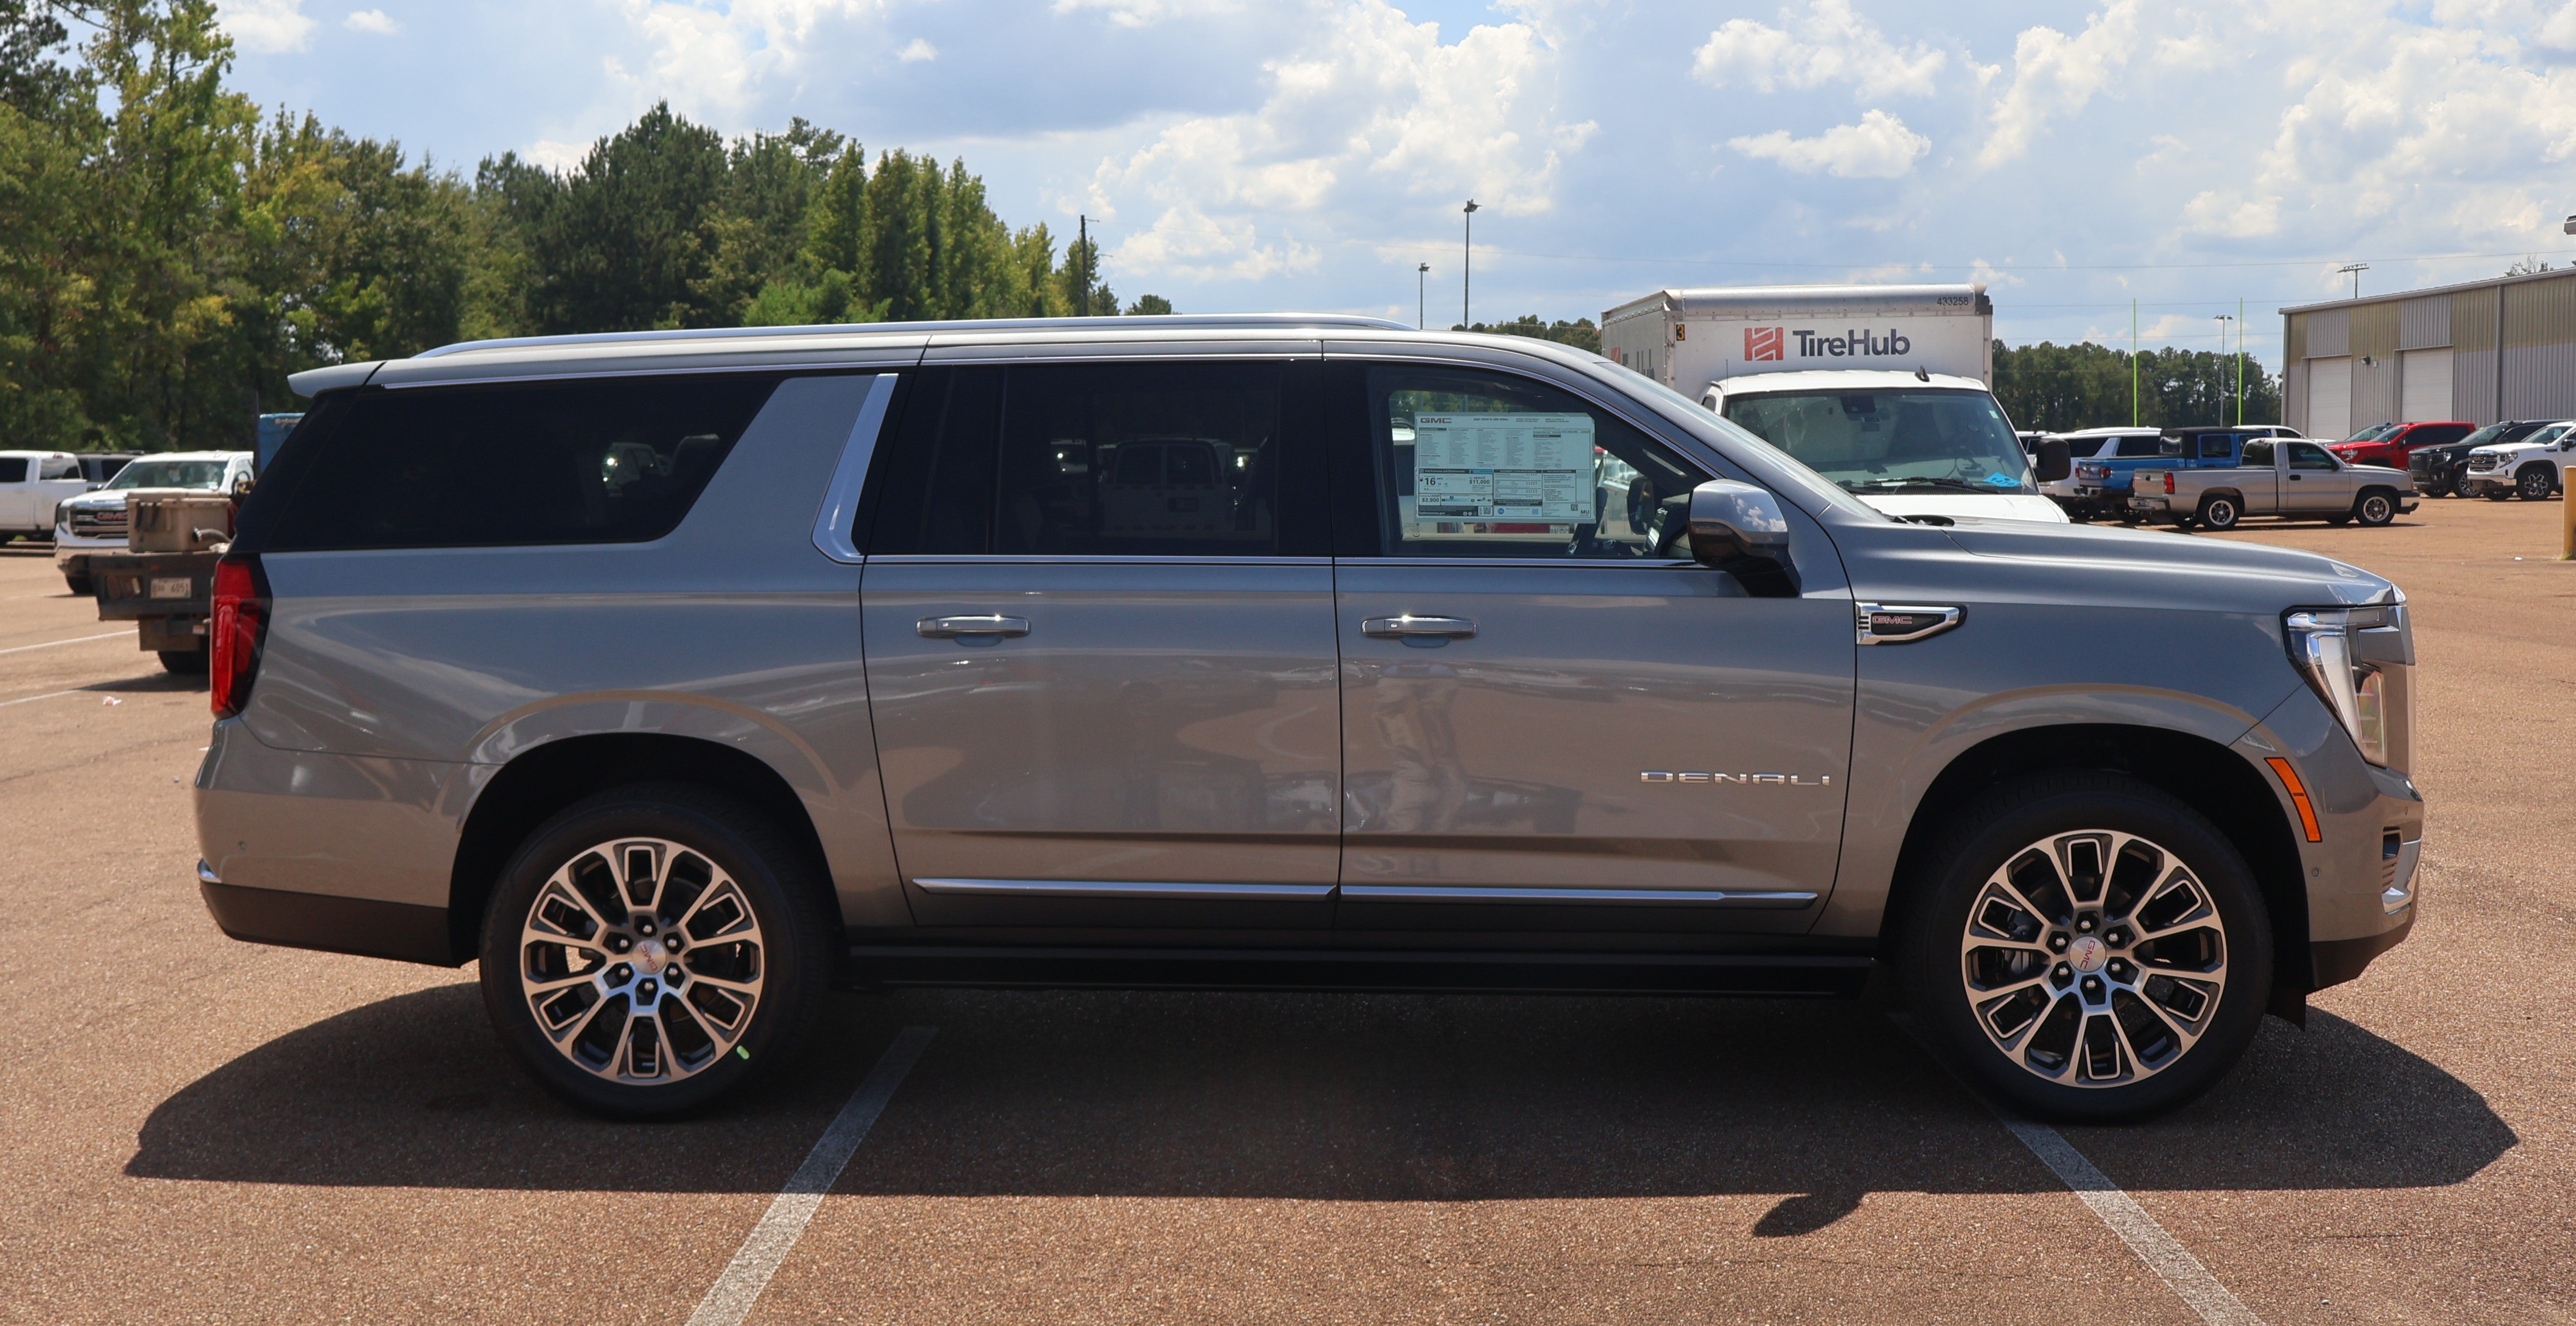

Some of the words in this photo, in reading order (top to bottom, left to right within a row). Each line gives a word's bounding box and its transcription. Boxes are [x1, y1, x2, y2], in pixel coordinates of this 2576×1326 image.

[1937, 297, 1969, 306] 433258
[1677, 325, 1684, 340] 3
[1793, 329, 1910, 357] TireHub
[1425, 477, 1436, 485] 16
[1872, 616, 1912, 624] GMC
[1641, 771, 1830, 786] DENALI
[640, 944, 658, 971] GMC
[2080, 940, 2095, 970] GMC
